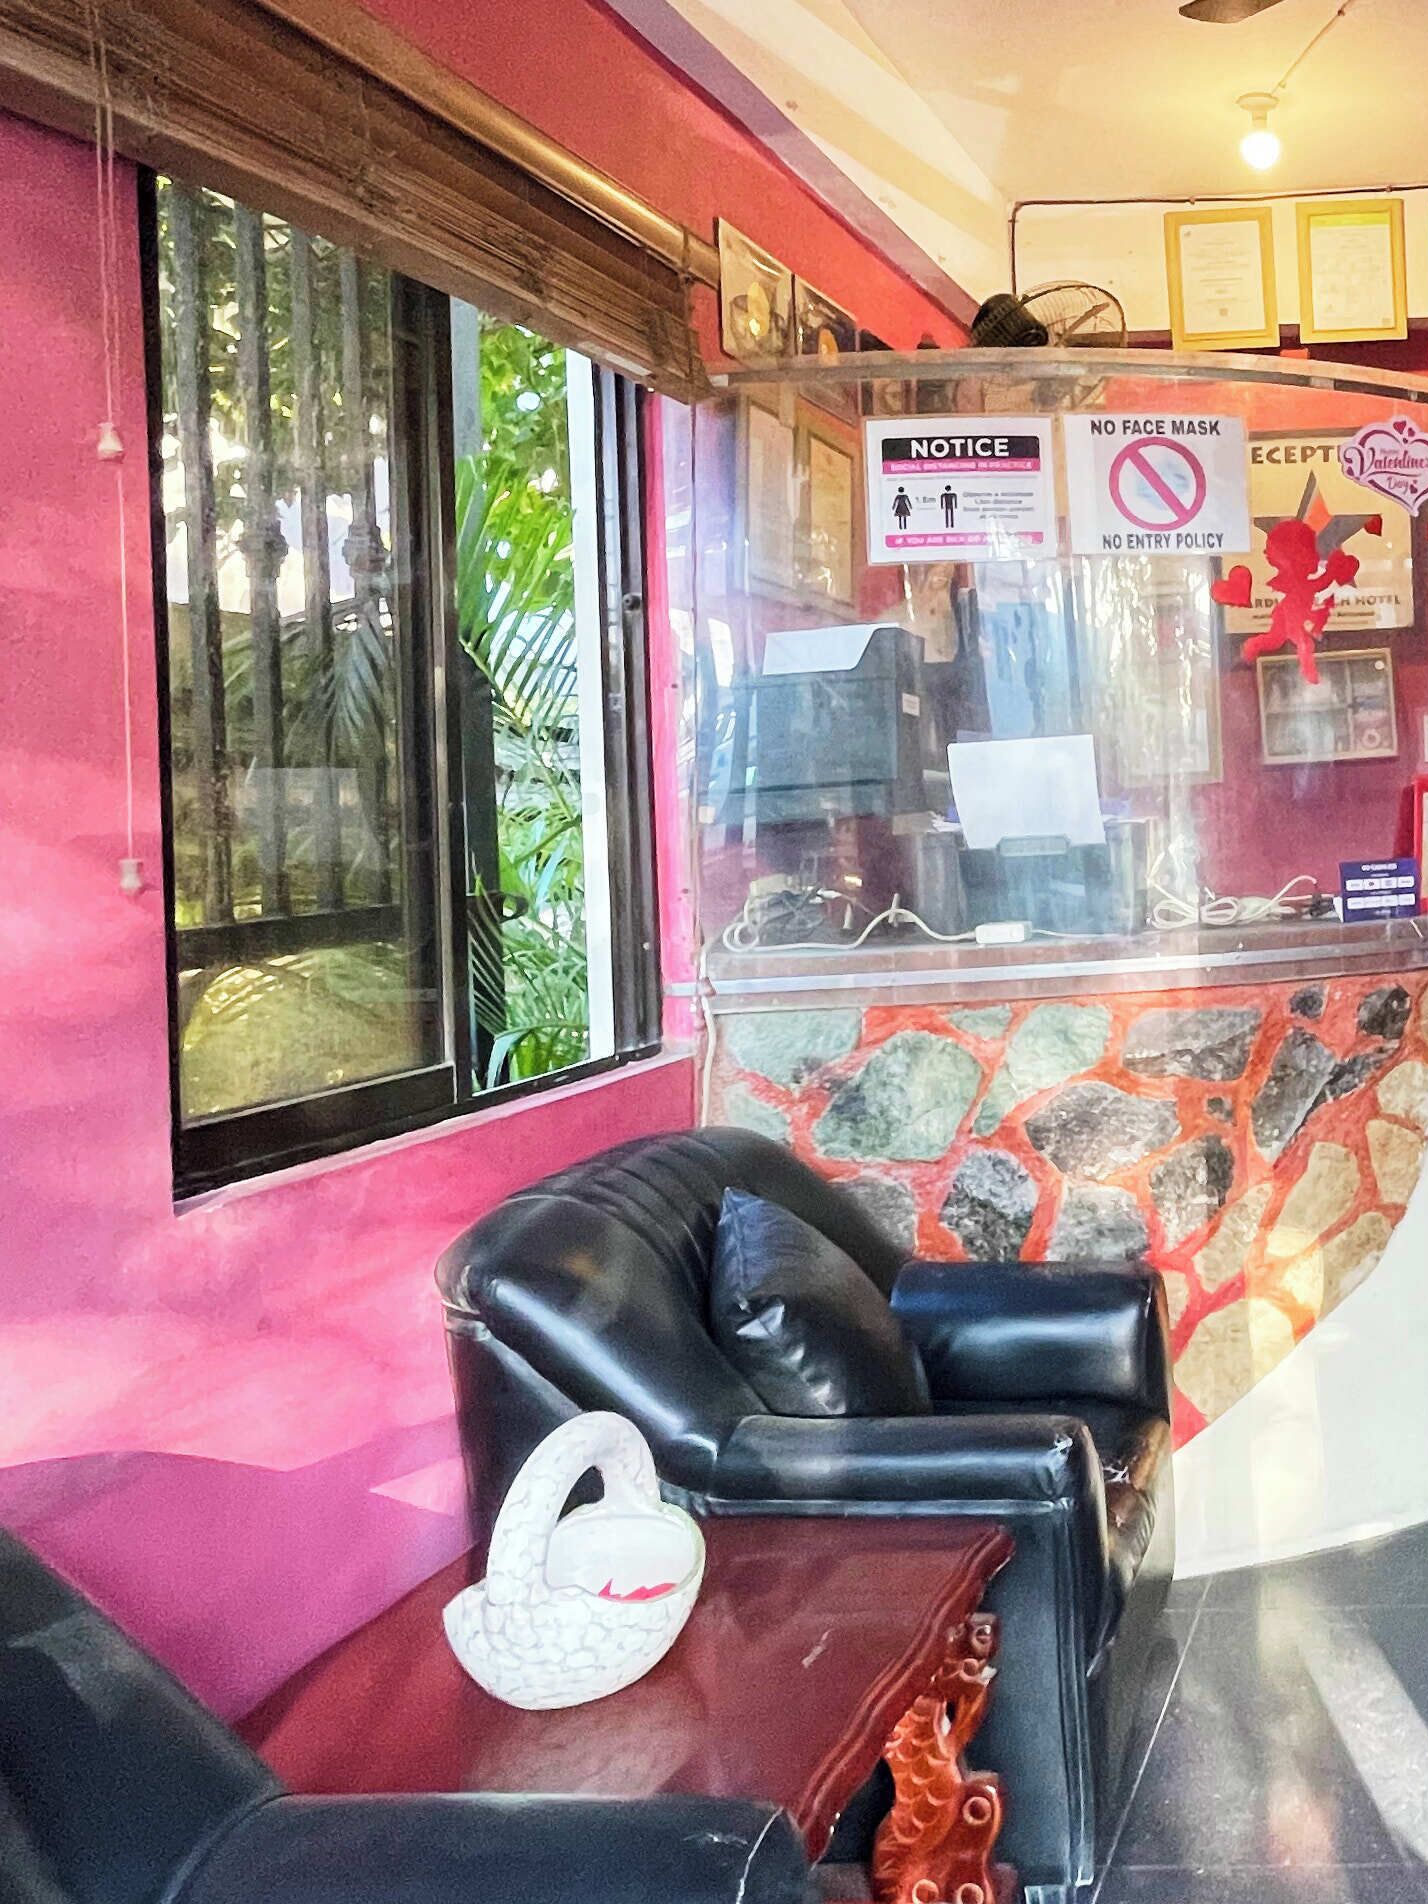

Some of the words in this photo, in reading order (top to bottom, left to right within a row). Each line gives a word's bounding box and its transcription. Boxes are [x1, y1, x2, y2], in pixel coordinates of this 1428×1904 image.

[1091, 419, 1116, 435] NO
[1122, 419, 1166, 435] FACE
[1171, 419, 1221, 436] MASK
[910, 438, 1010, 459] NOTICE
[1387, 476, 1410, 495] Day
[1102, 534, 1122, 549] NO
[1127, 533, 1171, 549] ENTRY
[1176, 532, 1224, 549] POLICY
[1355, 594, 1401, 607] HOTEL
